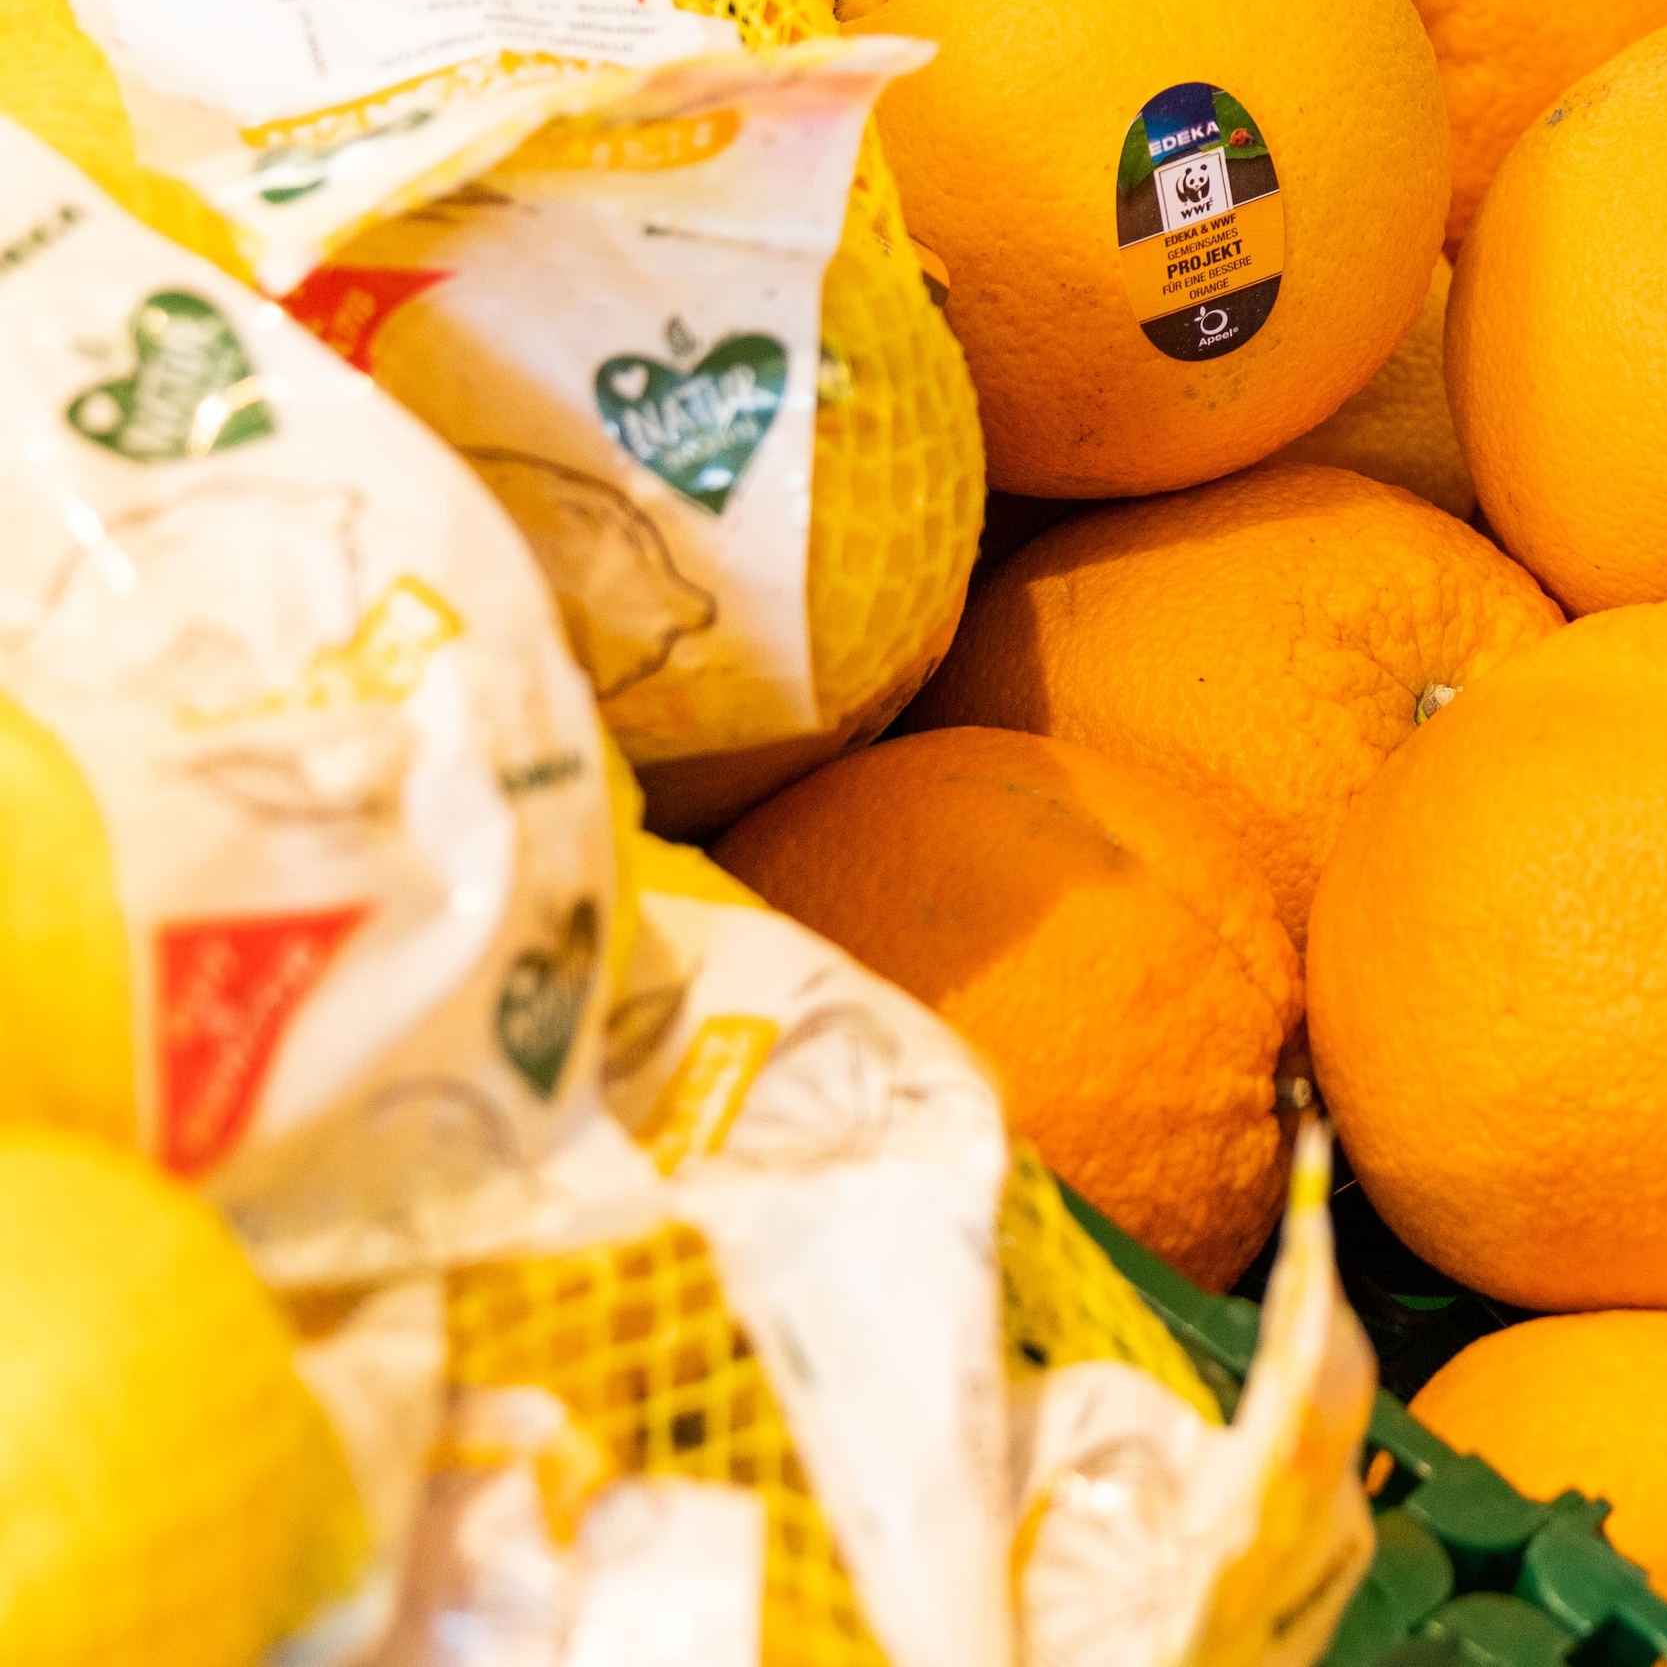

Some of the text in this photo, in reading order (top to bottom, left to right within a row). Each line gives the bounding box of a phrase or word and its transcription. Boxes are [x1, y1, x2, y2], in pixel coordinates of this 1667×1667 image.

[1149, 120, 1221, 158] EDEKA
[1181, 200, 1213, 219] WWF
[1164, 213, 1236, 248] EDEKA & WWF
[1167, 227, 1239, 261] GEMEINSAMES
[1162, 255, 1252, 295] FÜR EINE BESSERE
[1167, 239, 1243, 279] PROJEKT
[1189, 277, 1230, 300] ORANGE
